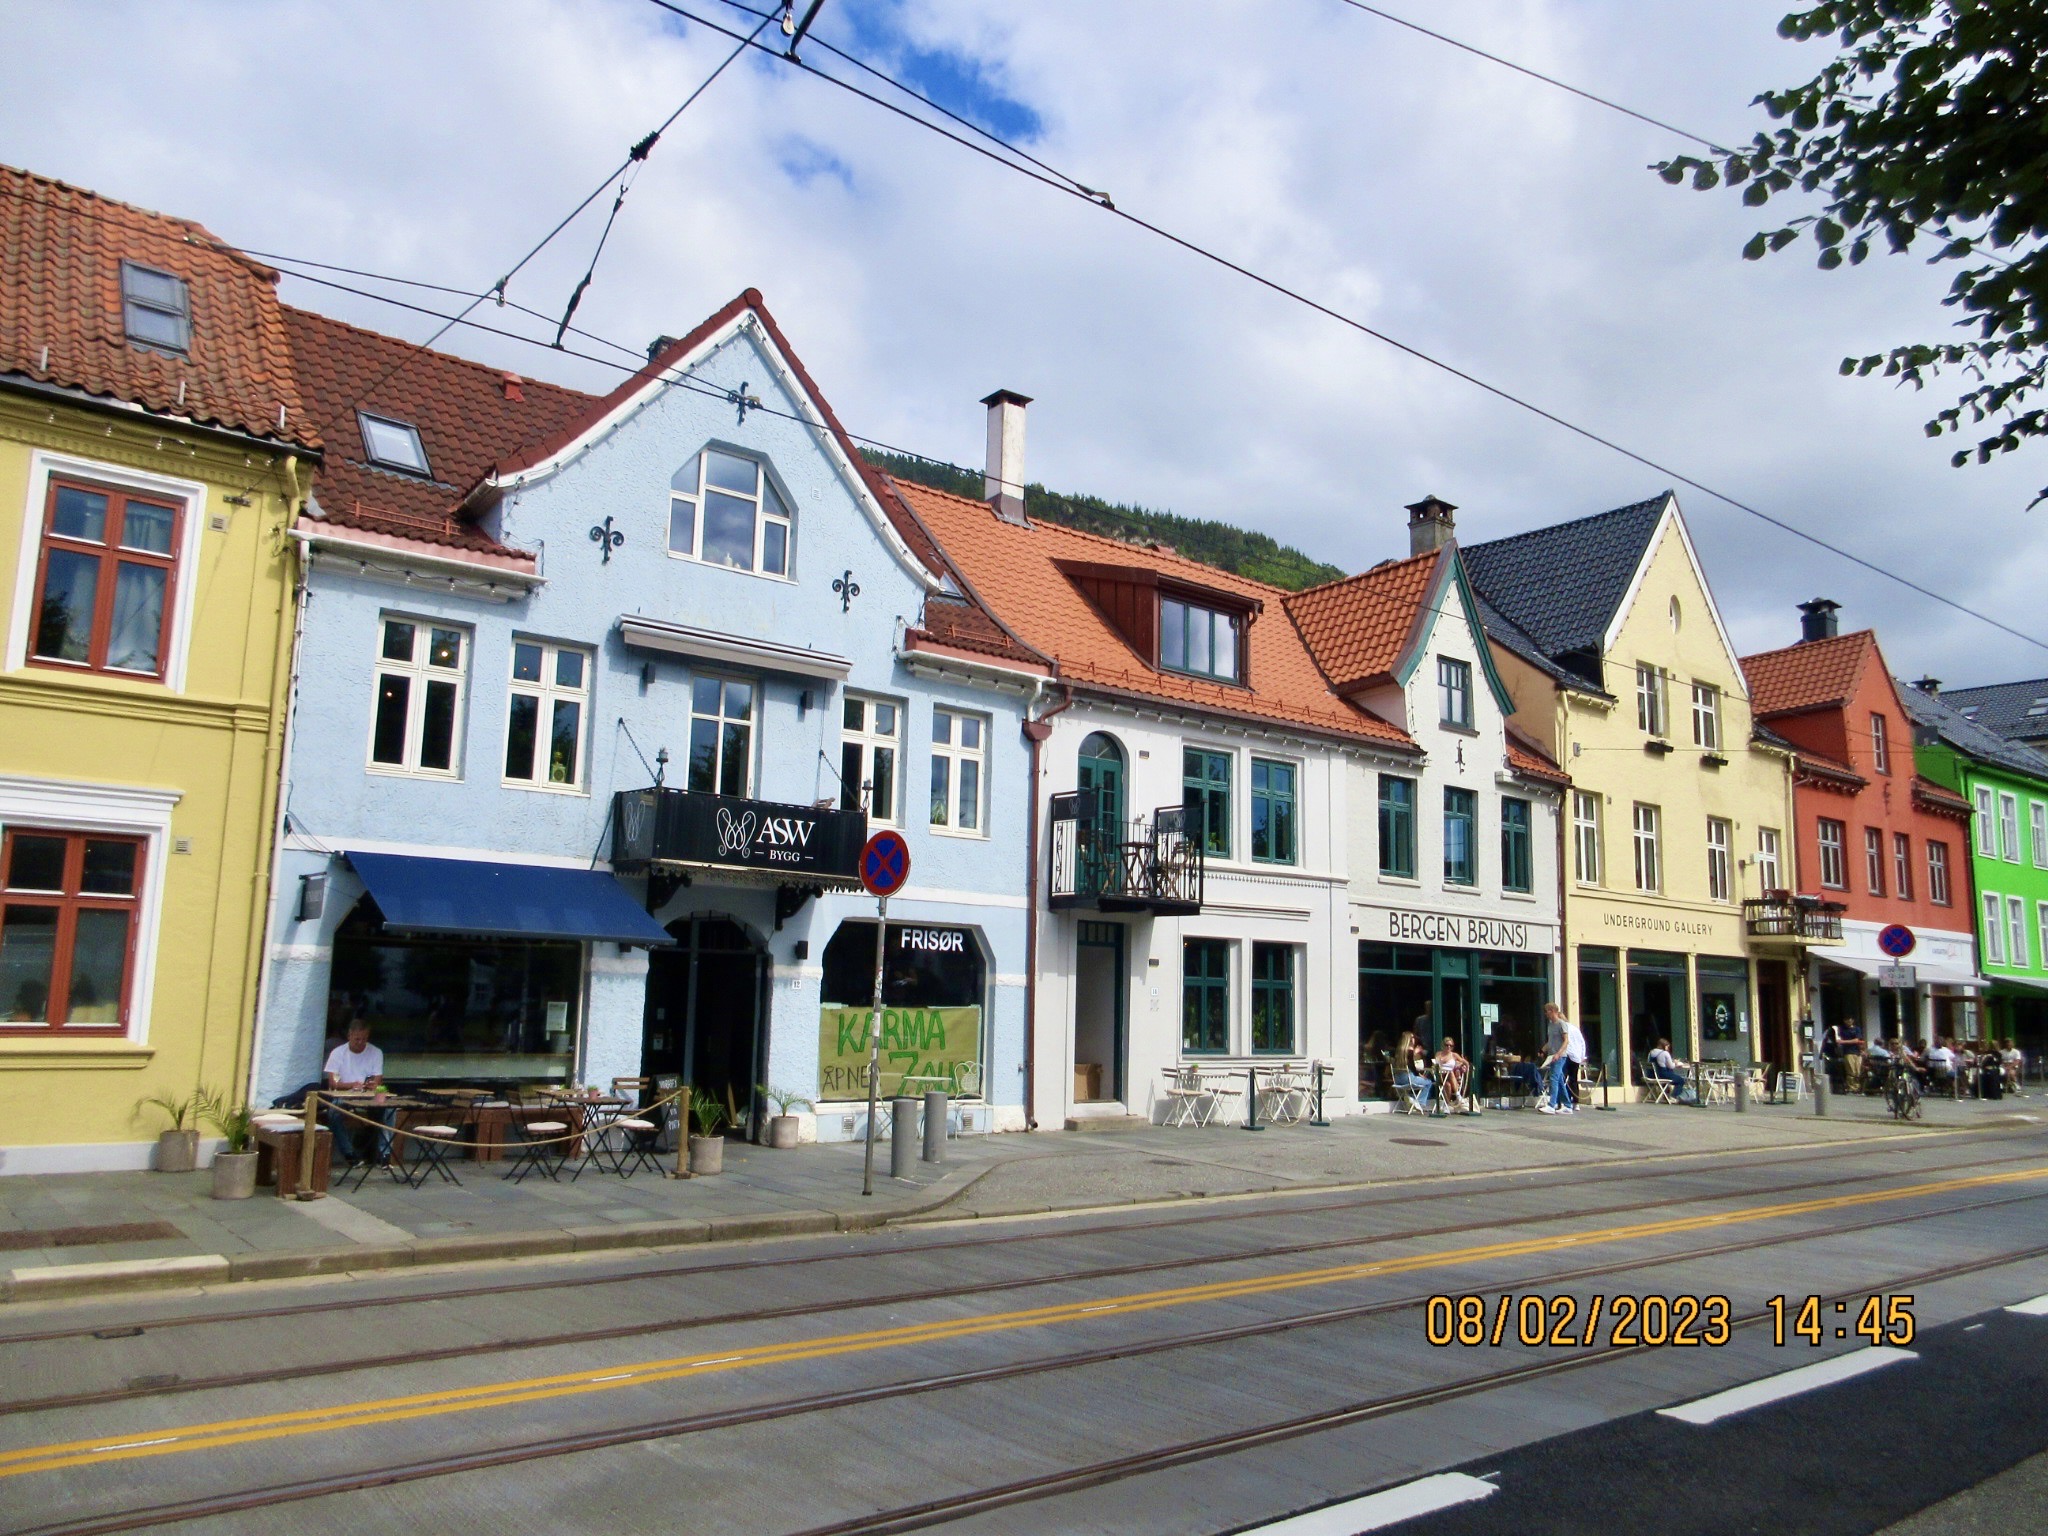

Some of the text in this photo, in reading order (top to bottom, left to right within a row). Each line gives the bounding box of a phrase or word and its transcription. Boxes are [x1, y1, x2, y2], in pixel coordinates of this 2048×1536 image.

[756, 816, 816, 847] ASW
[769, 849, 801, 862] BYGG
[1389, 912, 1460, 942] BERGEN
[1603, 913, 1713, 936] UNDERGROUND GALLERY
[901, 928, 964, 952] FRISØR
[838, 1009, 946, 1056] KARMA
